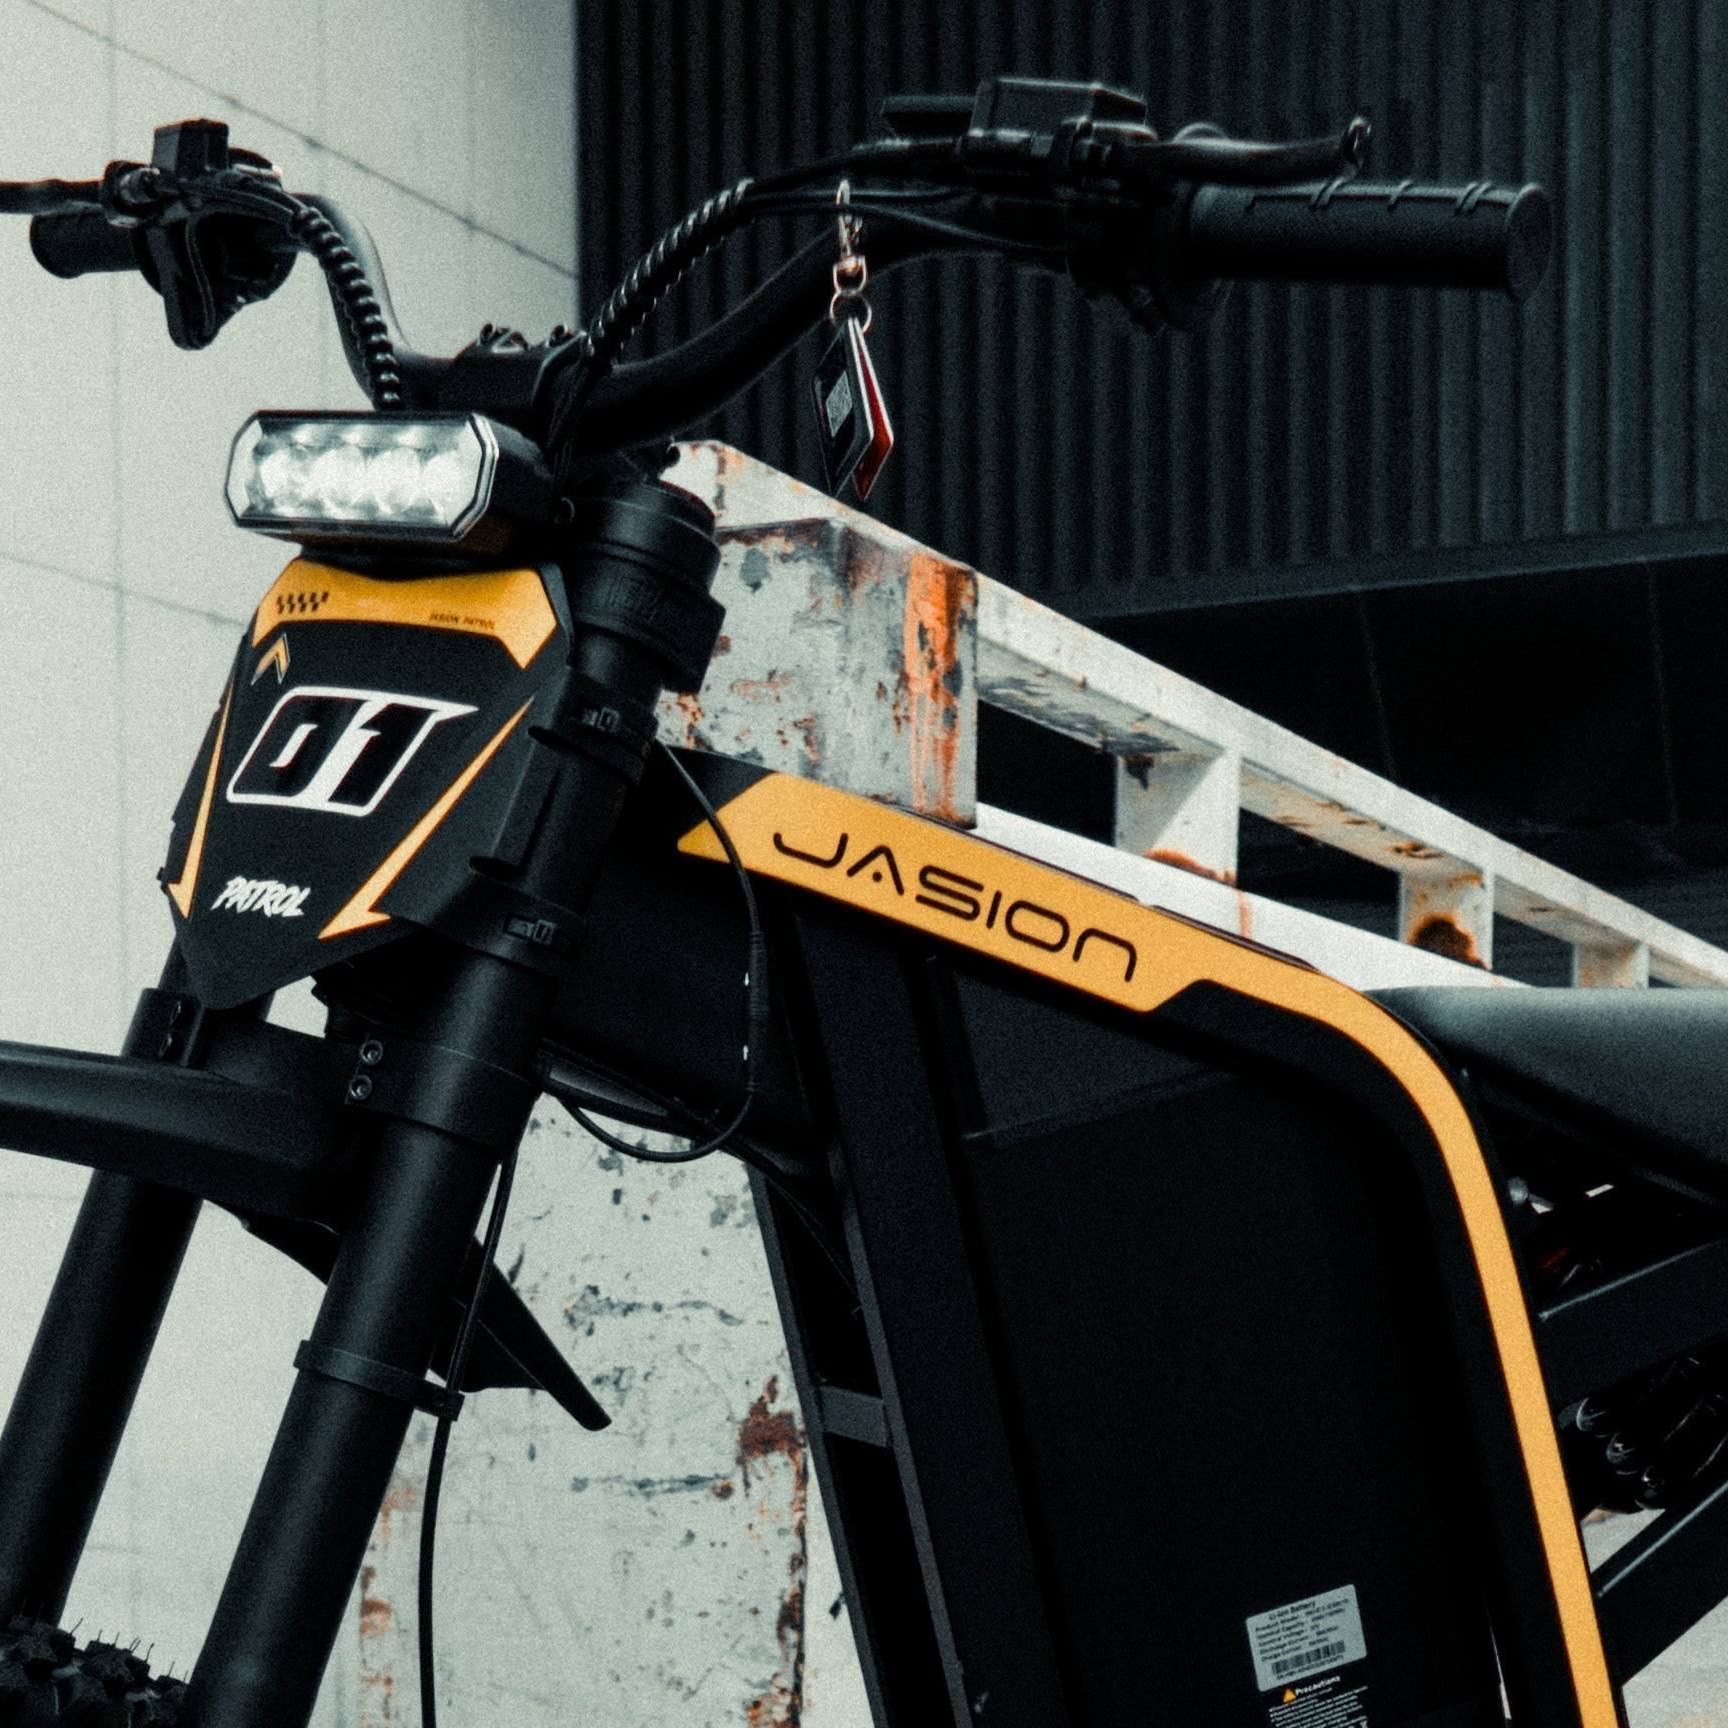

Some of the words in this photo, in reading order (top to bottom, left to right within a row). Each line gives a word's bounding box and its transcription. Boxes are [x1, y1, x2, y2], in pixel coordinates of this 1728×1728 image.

[227, 686, 479, 817] 01
[211, 875, 312, 917] PATROL
[772, 832, 1138, 983] JASION
[1295, 1675, 1341, 1695] Precautions
